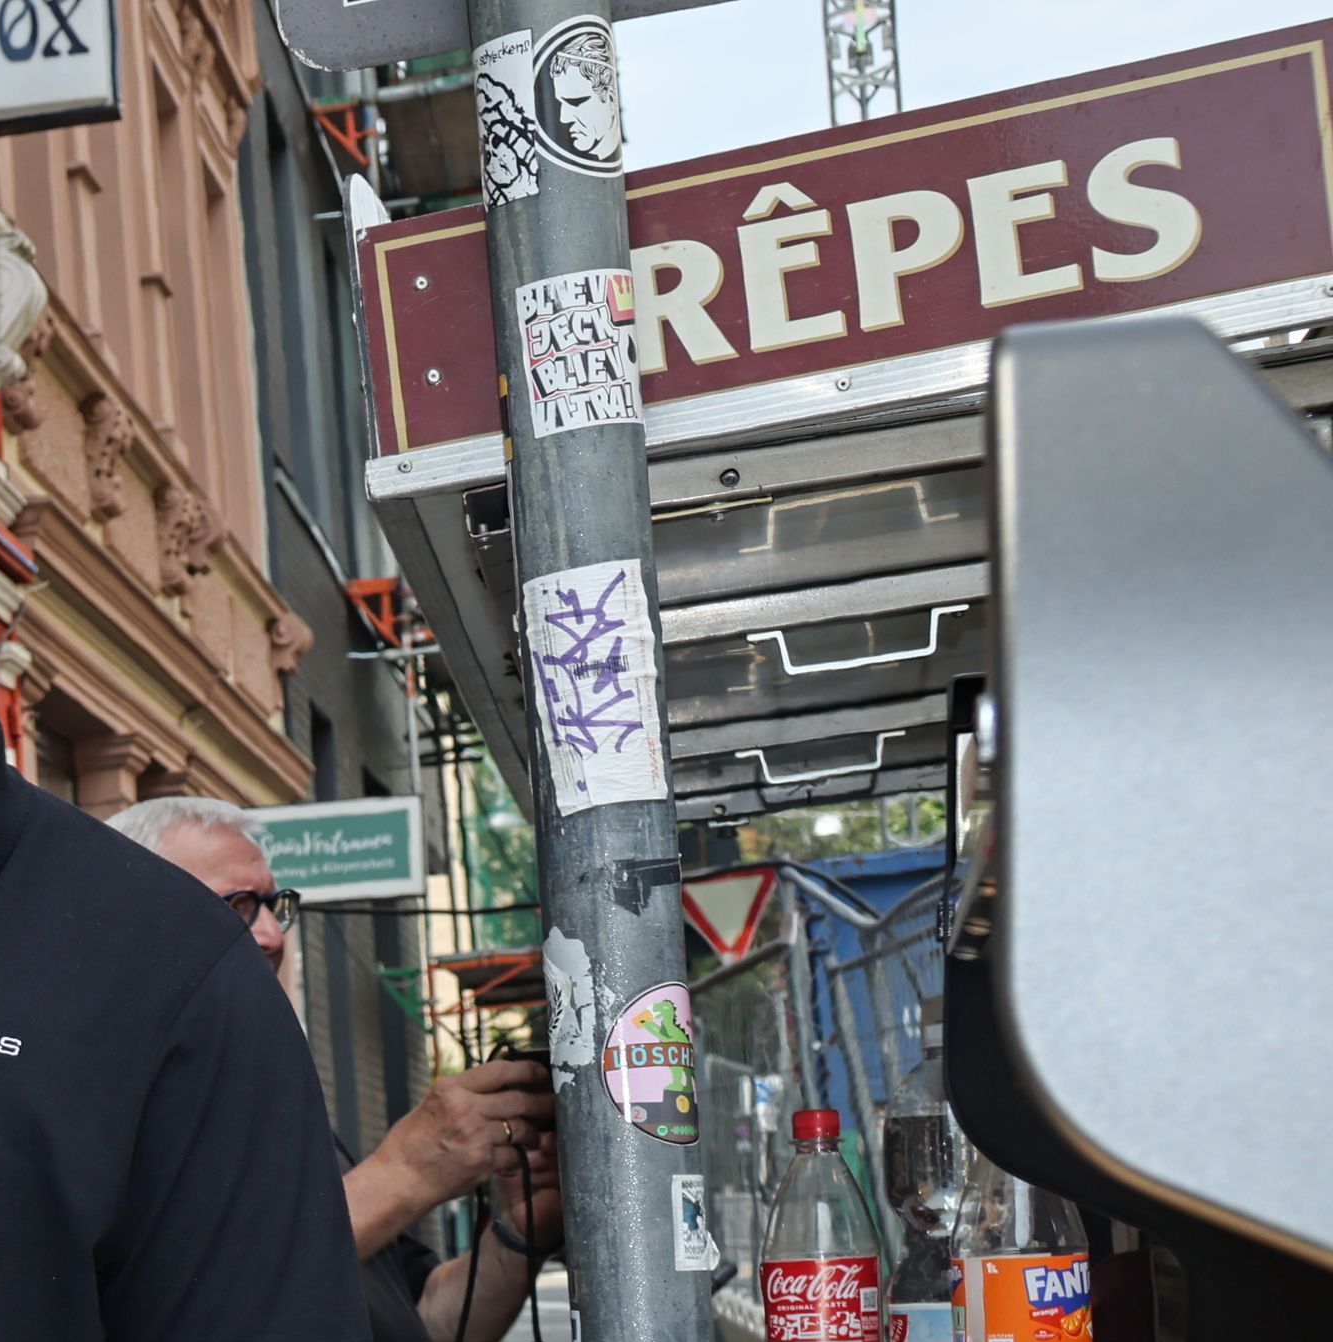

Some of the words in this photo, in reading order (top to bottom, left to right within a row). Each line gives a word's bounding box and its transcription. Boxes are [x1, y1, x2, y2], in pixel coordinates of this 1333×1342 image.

[632, 137, 1203, 374] RÊPES
[1024, 1261, 1091, 1302] FANT
[776, 1304, 815, 1312] ORIGINAL
[1032, 1307, 1059, 1318] orange
